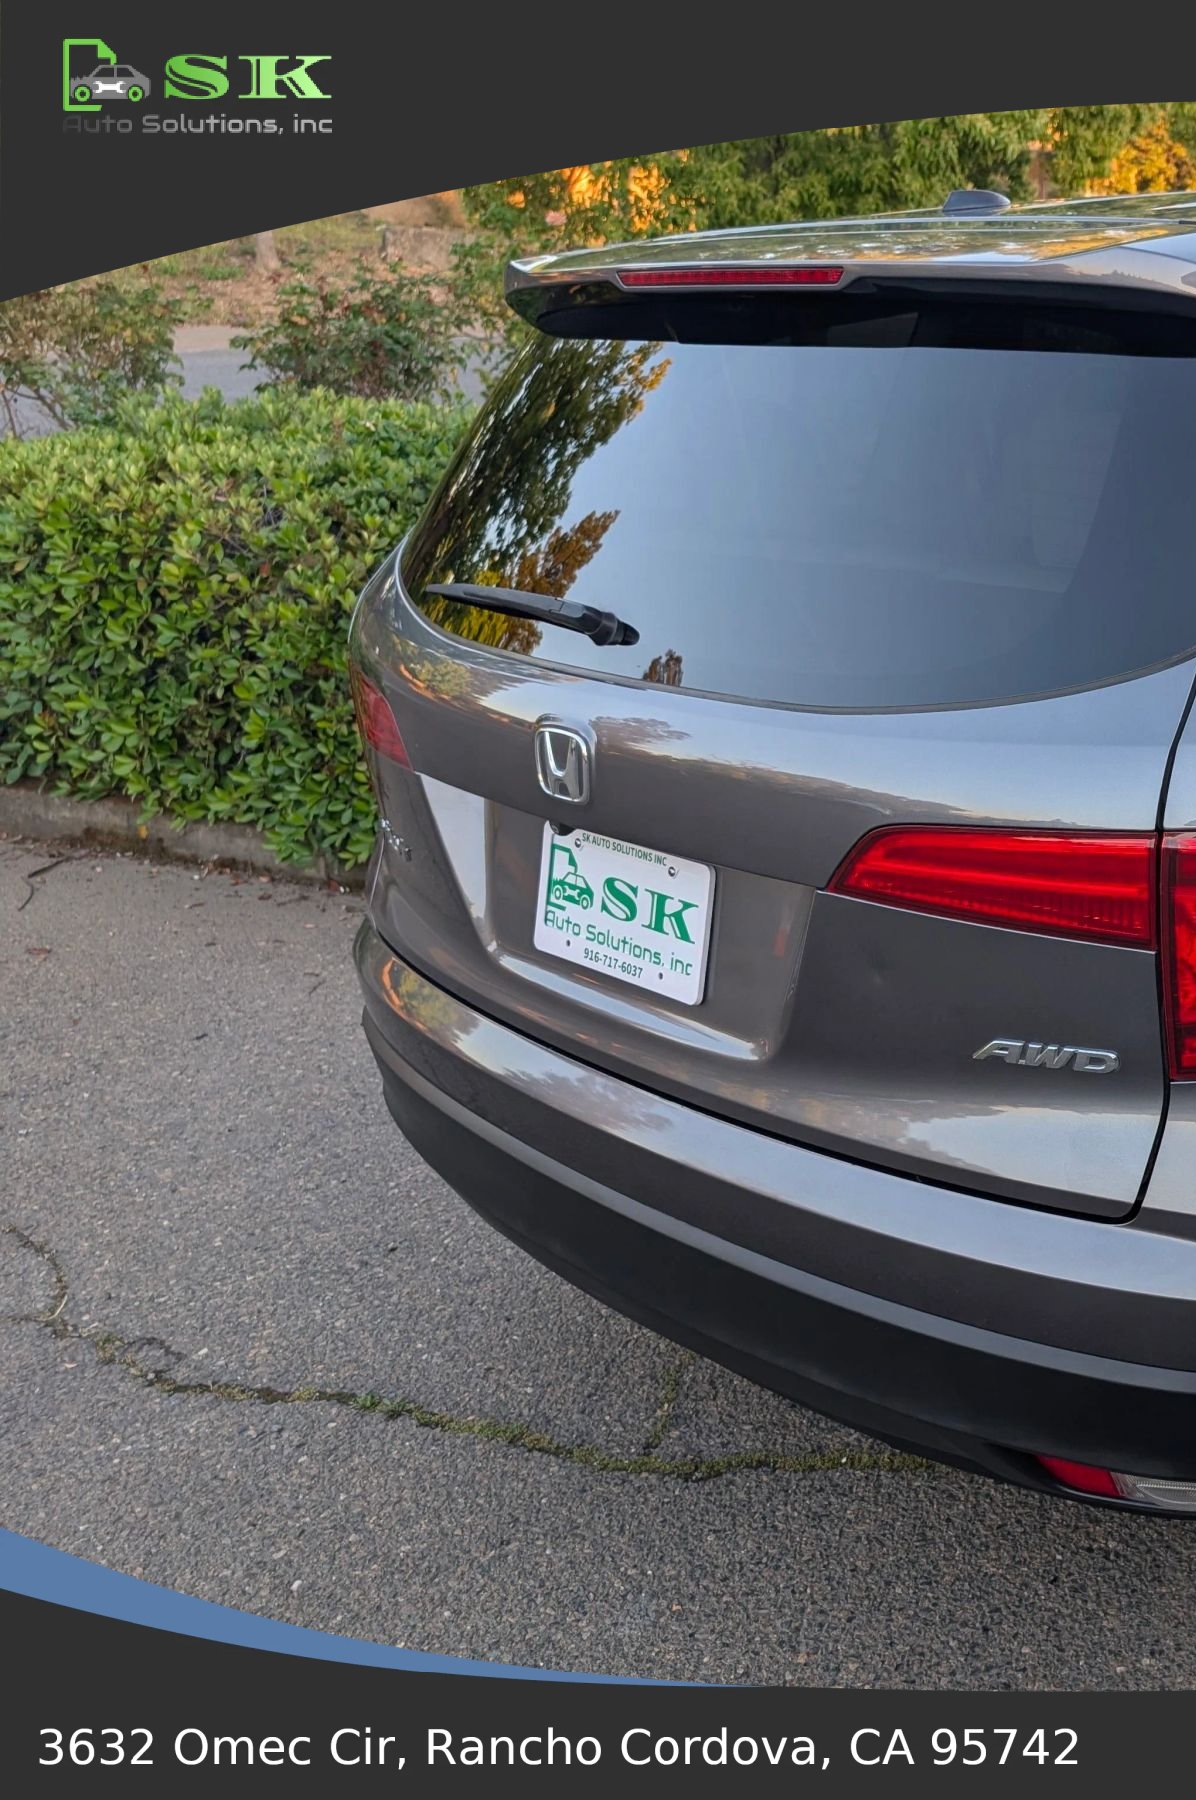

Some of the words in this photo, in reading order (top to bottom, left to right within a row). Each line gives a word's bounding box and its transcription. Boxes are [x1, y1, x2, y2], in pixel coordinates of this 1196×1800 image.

[581, 832, 592, 844] SK
[593, 835, 611, 850] AUTO
[612, 842, 653, 862] SOLUTIONS
[654, 855, 667, 867] INC
[601, 877, 699, 944] SK
[545, 910, 582, 936] Auto
[585, 924, 665, 967] Solutions,
[670, 952, 693, 976] inc
[583, 947, 643, 979] 916-717-6037
[971, 1039, 1119, 1074] AWD
